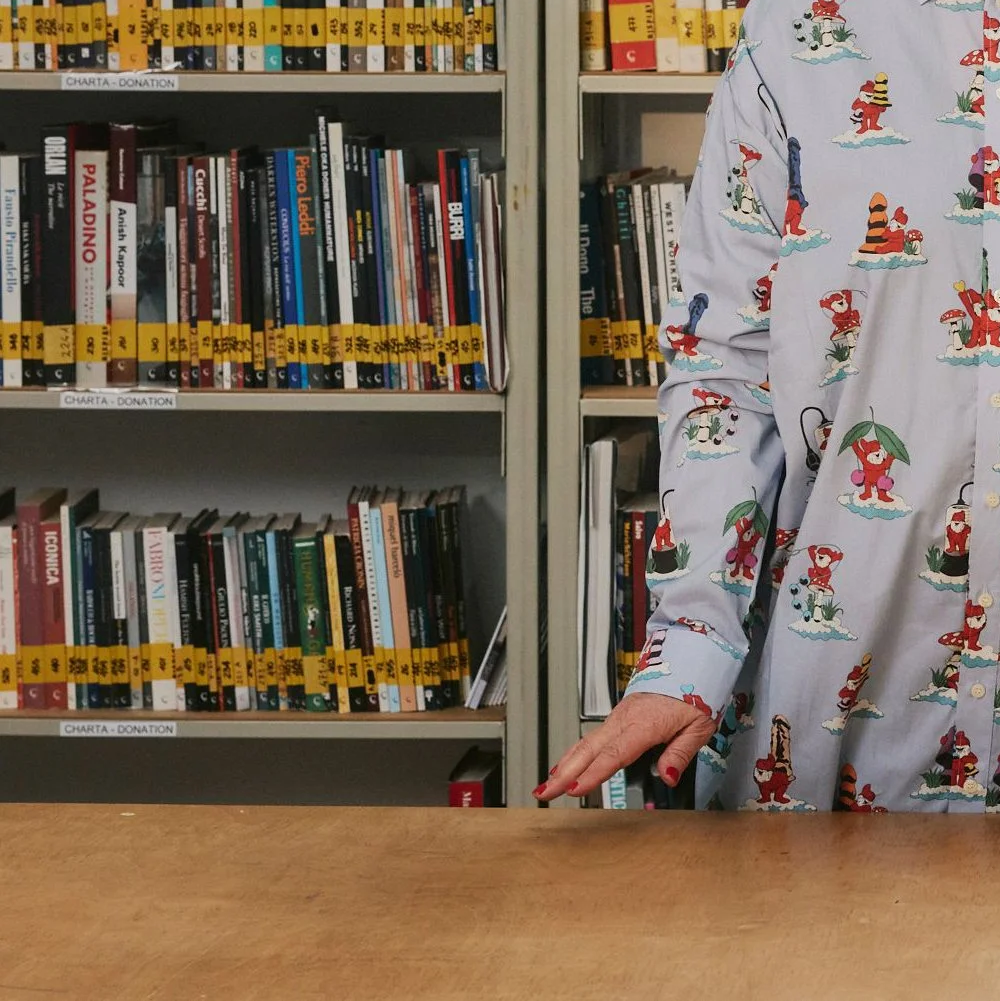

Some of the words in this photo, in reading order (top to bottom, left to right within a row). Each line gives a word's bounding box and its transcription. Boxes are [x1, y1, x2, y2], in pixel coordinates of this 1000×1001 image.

[66, 77, 109, 86] CHARTA
[119, 78, 174, 88] DONATION
[319, 116, 328, 151] MICHELE
[45, 136, 67, 176] ORLAN
[295, 156, 310, 193] Piero
[194, 168, 208, 211] Cucchi
[4, 189, 17, 228] Fausto
[82, 163, 97, 264] PALADINO
[117, 207, 127, 241] Anish
[297, 196, 314, 236] Leddi
[448, 202, 465, 240] BURRI
[615, 188, 630, 241] Ghitti
[664, 201, 674, 233] WEST
[5, 231, 18, 293] Pirandello
[116, 245, 127, 288] Kapoor
[64, 395, 108, 405] CHARTA
[117, 396, 173, 406] DONATION
[351, 517, 362, 554] PATRICIA
[635, 520, 643, 539] Salvo
[44, 530, 60, 586] ICONICA
[343, 586, 353, 623] RICHARD
[64, 725, 109, 734] CHARTA
[117, 725, 174, 734] DONATION
